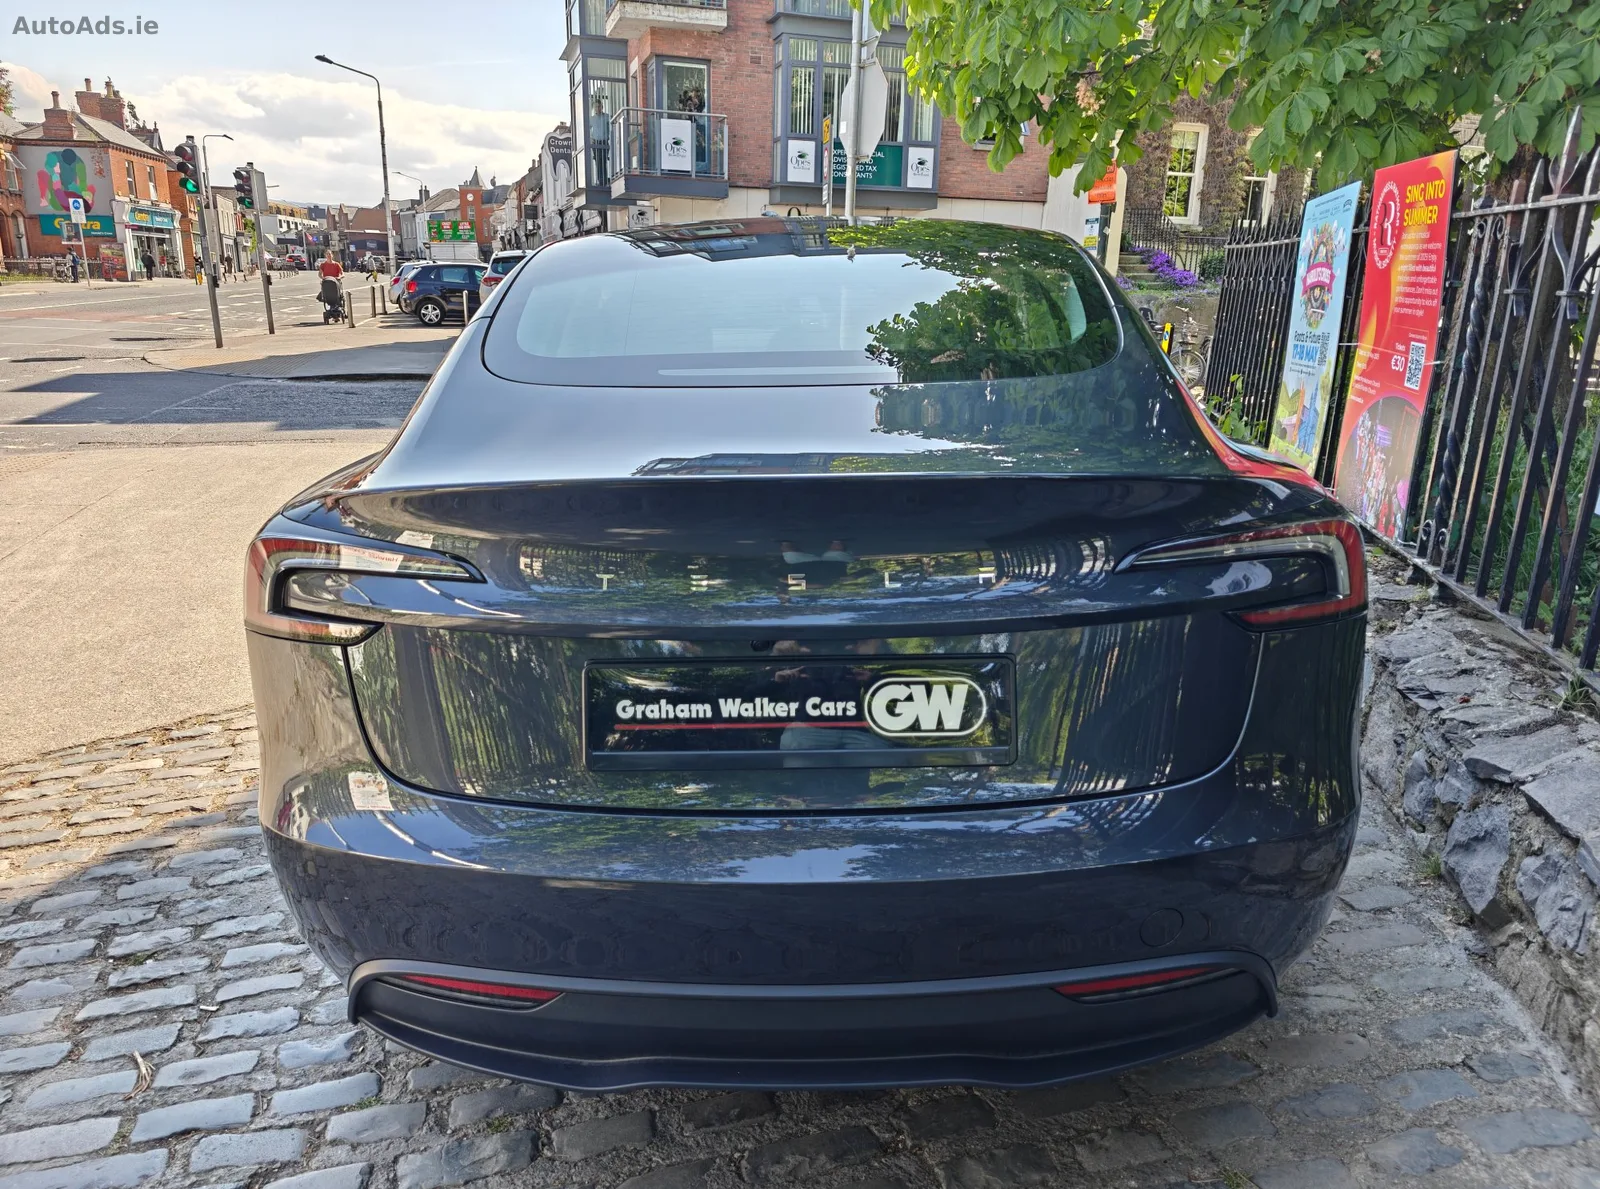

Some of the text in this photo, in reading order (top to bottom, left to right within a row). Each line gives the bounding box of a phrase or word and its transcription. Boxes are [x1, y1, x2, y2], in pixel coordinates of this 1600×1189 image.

[1406, 179, 1446, 204] SING INTO
[54, 218, 100, 230] Ctra
[1404, 206, 1438, 226] SUMMER
[1304, 345, 1319, 363] MAY
[1391, 354, 1406, 372] €30
[616, 683, 969, 731] Graham Walker Cars GW
